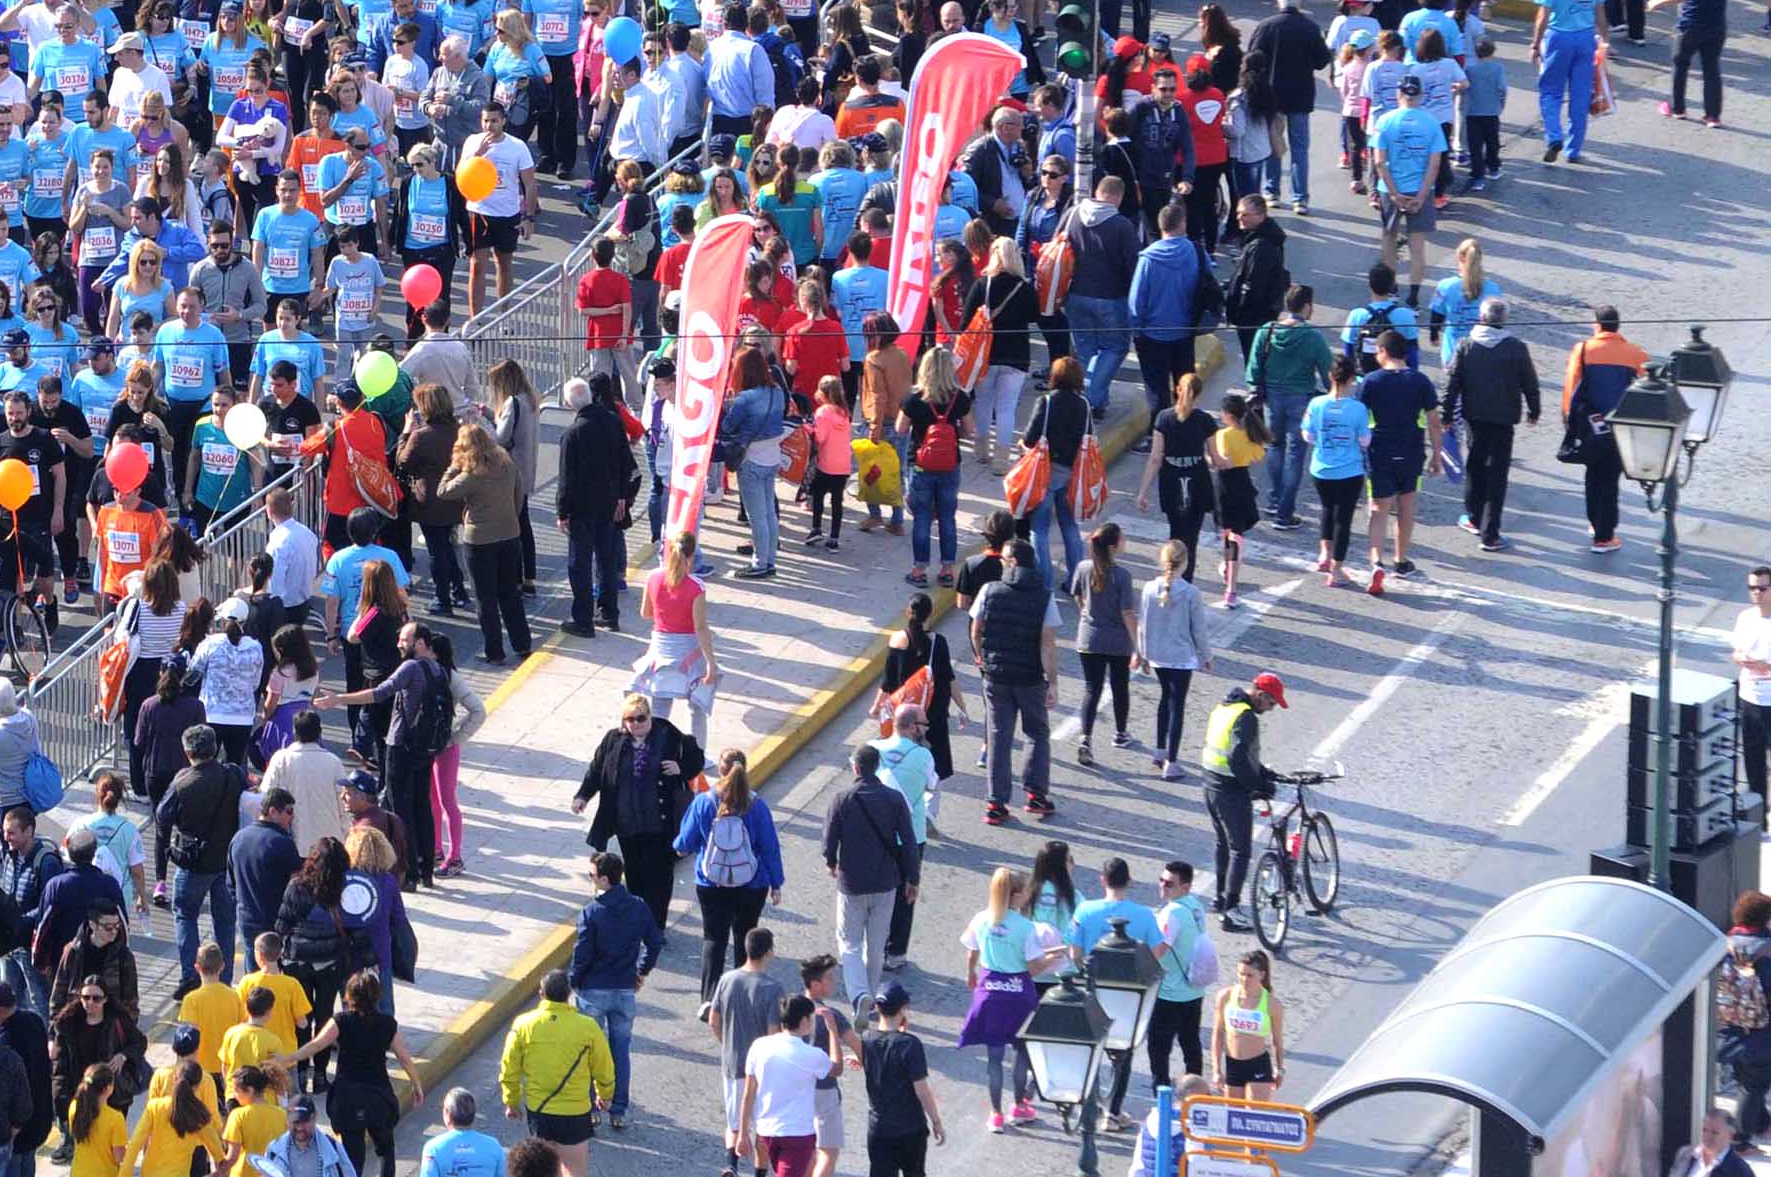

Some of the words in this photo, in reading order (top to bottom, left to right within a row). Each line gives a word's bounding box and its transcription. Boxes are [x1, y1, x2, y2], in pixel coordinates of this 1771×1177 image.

[60, 74, 86, 83] 30376
[416, 224, 441, 233] 30250
[172, 366, 199, 375] 30962
[986, 981, 1023, 992] adidas
